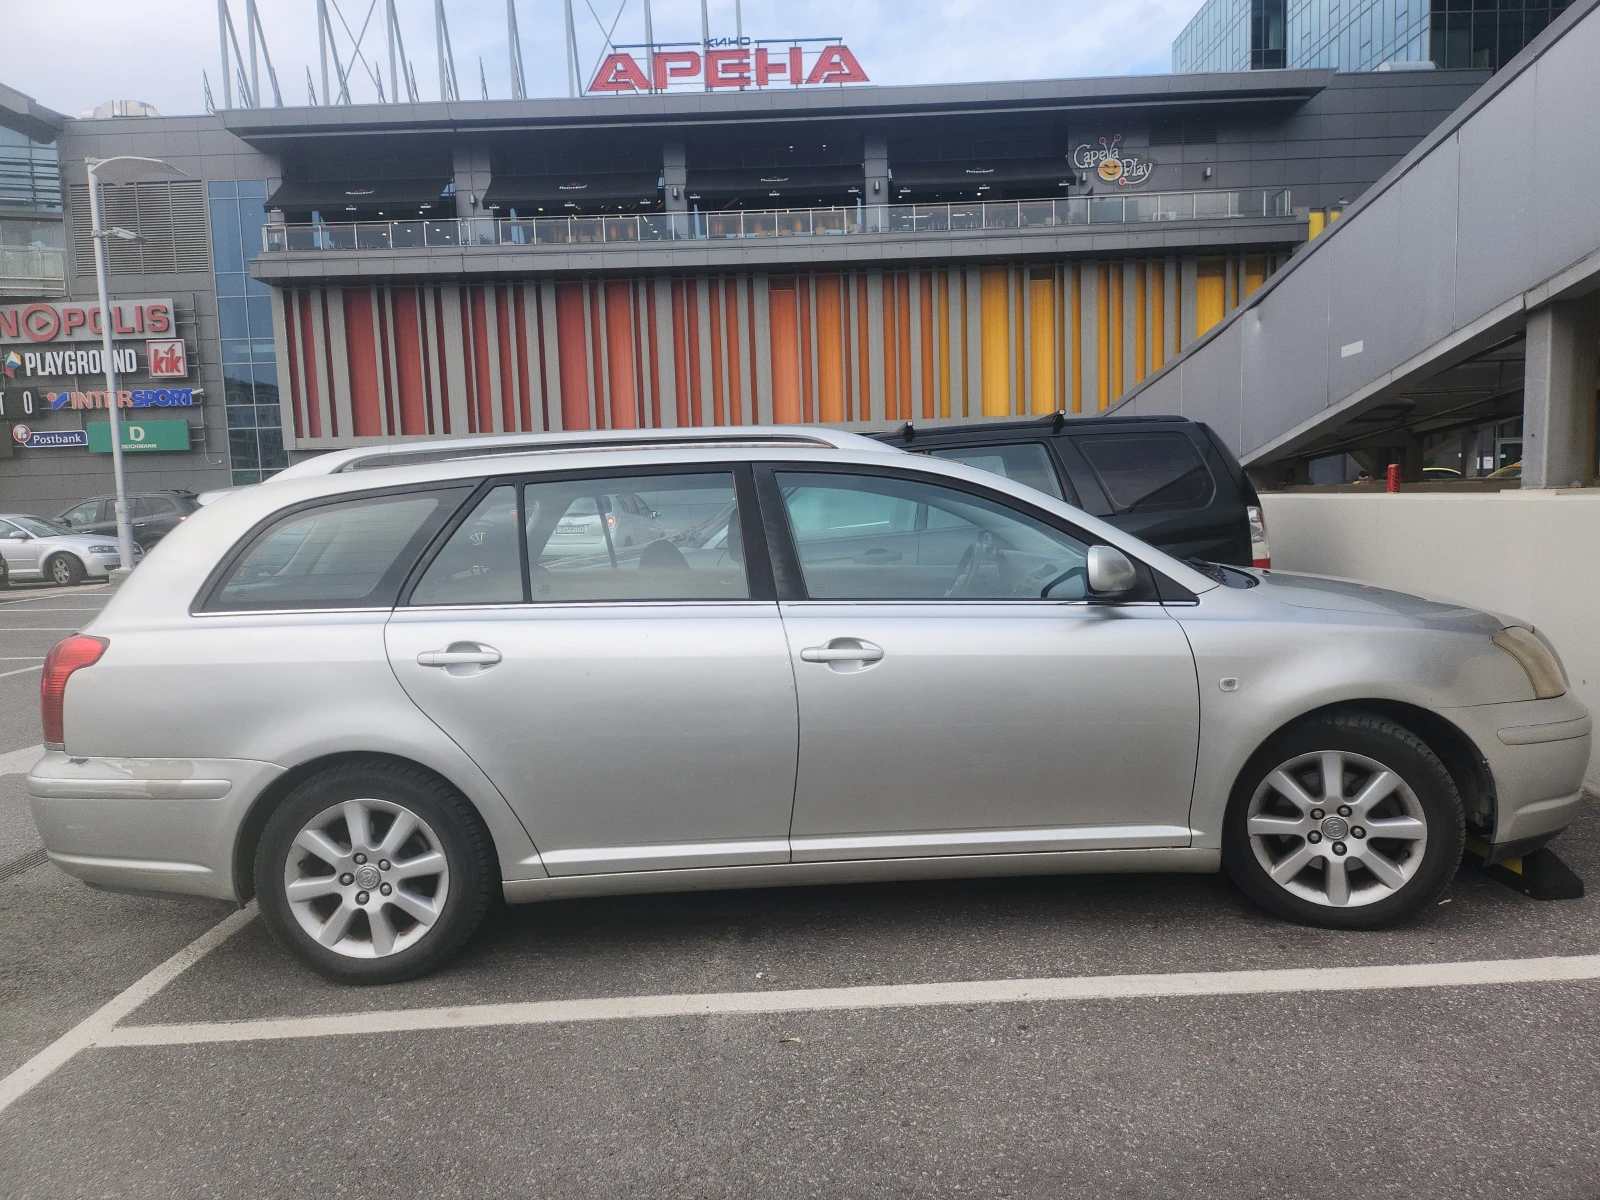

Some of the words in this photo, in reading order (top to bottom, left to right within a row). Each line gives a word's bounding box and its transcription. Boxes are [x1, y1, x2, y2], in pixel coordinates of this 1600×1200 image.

[704, 37, 751, 48] КИНО
[588, 45, 870, 92] АРЕНА
[1121, 158, 1153, 184] Play
[33, 433, 82, 444] Postbank
